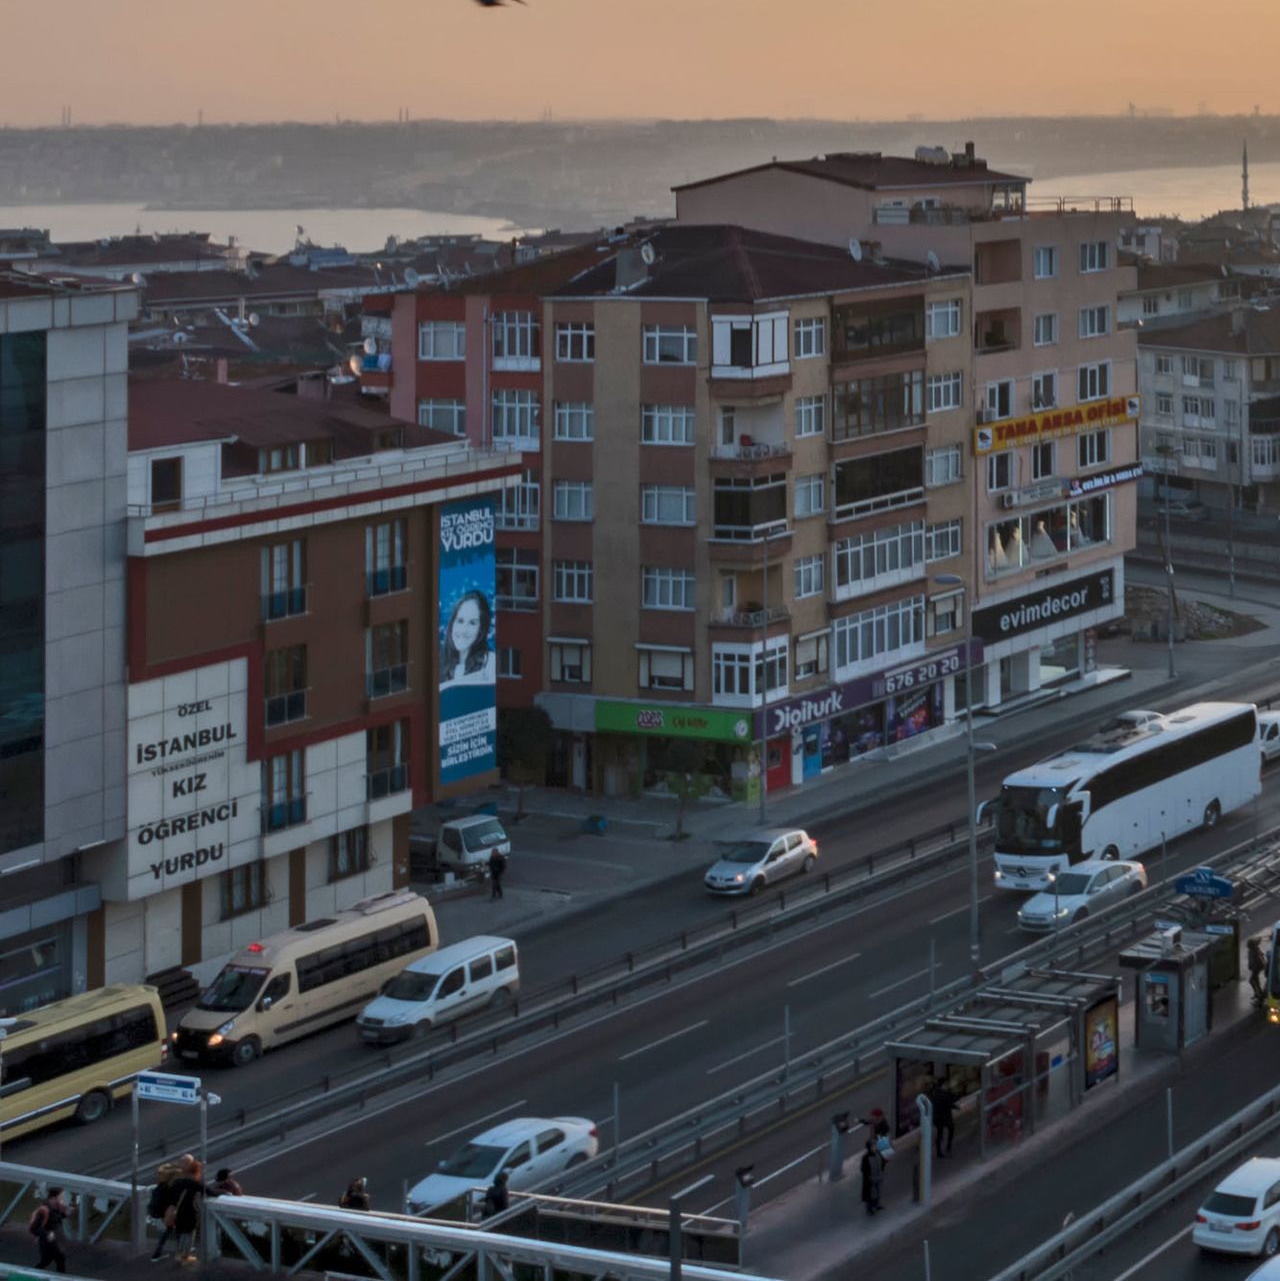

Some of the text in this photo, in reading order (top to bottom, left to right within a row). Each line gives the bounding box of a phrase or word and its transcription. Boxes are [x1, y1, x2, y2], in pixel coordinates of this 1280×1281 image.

[441, 529, 493, 552] YURDU
[1000, 589, 1087, 631] evimdecor
[886, 656, 960, 693] 676 20 20
[178, 700, 212, 717] ÖZEL
[137, 723, 237, 764] İSTANBUL
[173, 773, 207, 798] KIZ
[137, 797, 238, 846] ÖĞRENCİ
[150, 843, 224, 880] YURDU
